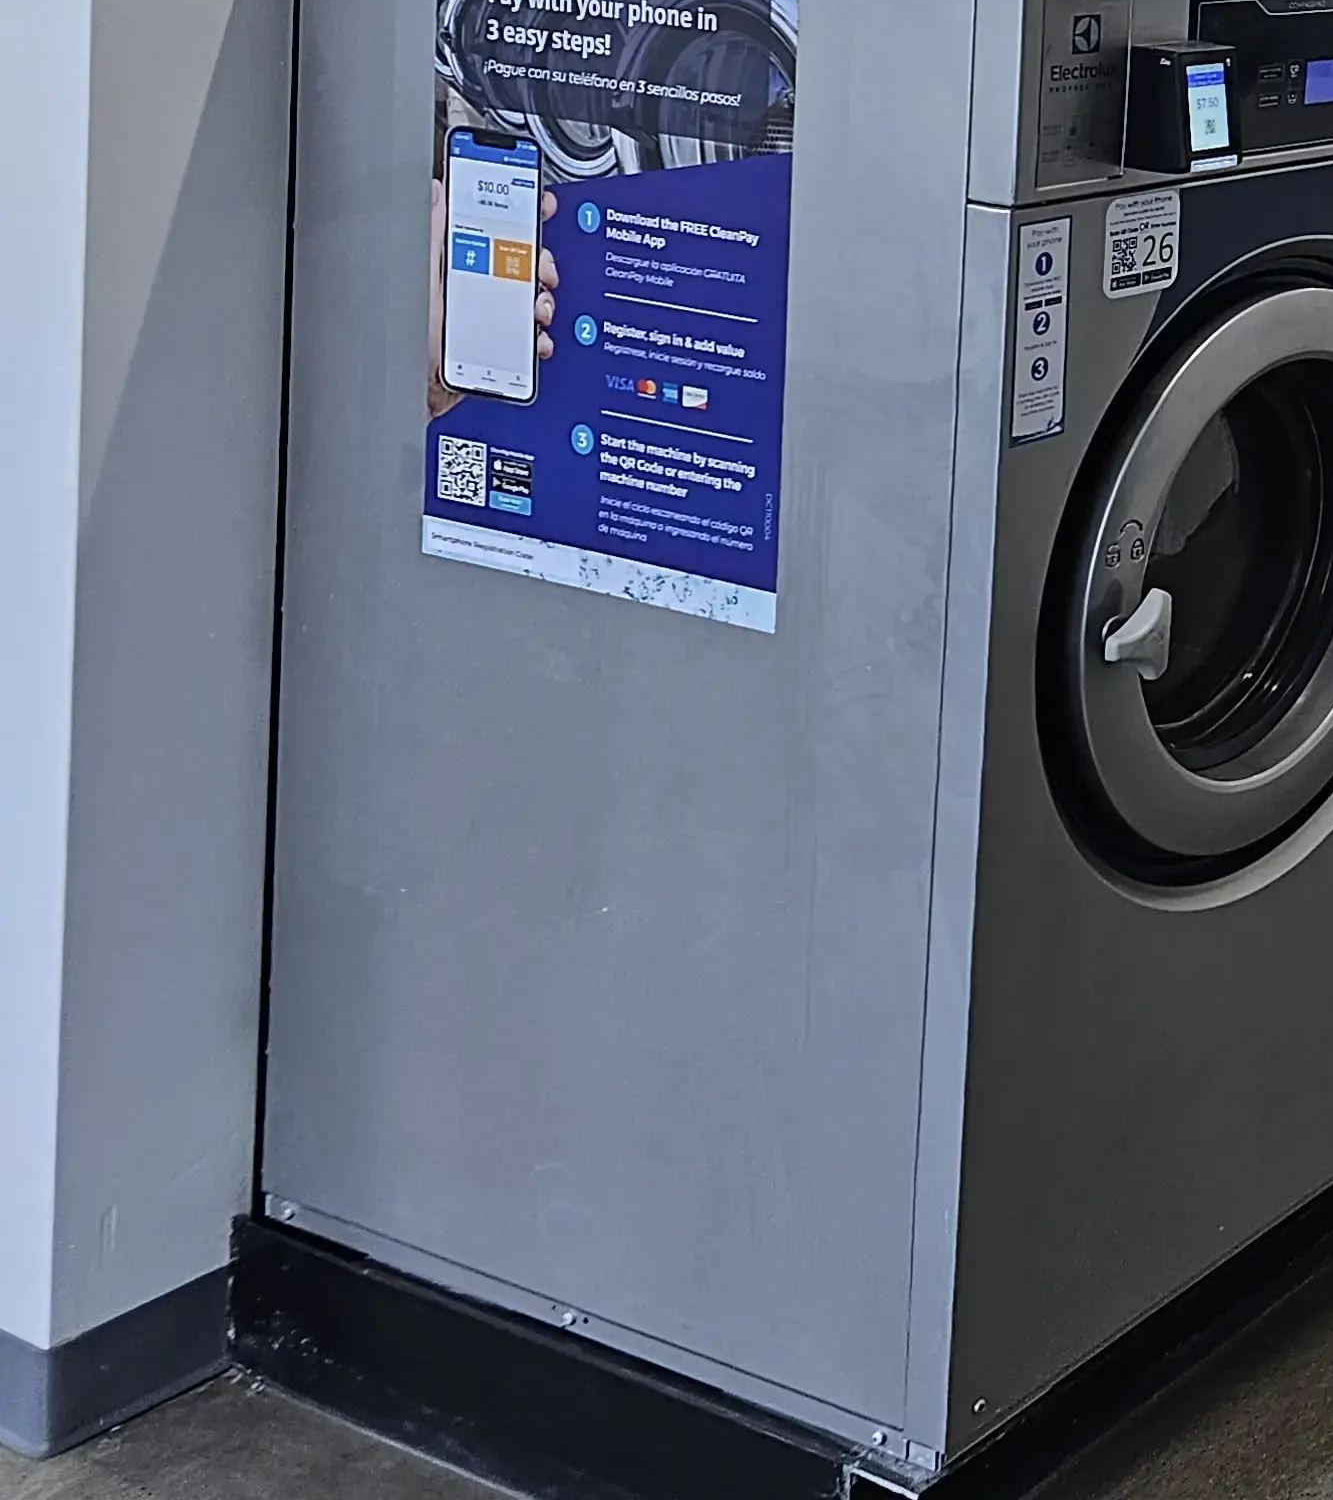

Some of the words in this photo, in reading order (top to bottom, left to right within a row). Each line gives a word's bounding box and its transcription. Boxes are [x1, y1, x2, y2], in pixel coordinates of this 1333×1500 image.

[628, 0, 693, 27] phone
[697, 6, 718, 31] in
[486, 19, 499, 40] 3
[503, 25, 548, 52] easy
[552, 30, 611, 59] steps!
[527, 67, 550, 79] con
[552, 71, 567, 82] su
[568, 72, 618, 89] teléfono
[619, 80, 636, 91] en
[636, 80, 646, 93] 3
[646, 84, 699, 100] sencillos
[700, 92, 741, 107] pasos!
[476, 179, 510, 196] $10.00
[605, 227, 642, 244] Mobile
[643, 234, 666, 249] App
[606, 209, 660, 229] Download
[661, 218, 679, 232] the
[680, 221, 709, 237] FREE
[709, 226, 760, 247] CleanPay
[1142, 232, 1174, 267] 26
[605, 267, 645, 283] CleanPay
[645, 274, 674, 287] Mobile
[703, 268, 746, 284] GRATUITA
[603, 321, 648, 341] Register,
[649, 331, 671, 346] sign
[672, 333, 683, 347] in
[684, 336, 693, 348] &
[694, 339, 715, 352] add
[716, 344, 745, 358] value
[605, 374, 635, 393] VISA
[743, 368, 767, 381] saldo
[600, 433, 627, 450] Start
[627, 439, 645, 453] the
[646, 444, 692, 463] machine
[693, 452, 708, 468] by
[708, 457, 756, 479] scanning
[600, 451, 618, 466] the
[618, 456, 636, 470] QR
[637, 460, 664, 476] Code
[664, 467, 677, 478] or
[677, 469, 722, 490] entering
[723, 477, 742, 491] the
[599, 471, 645, 489] machine
[645, 479, 688, 498] number
